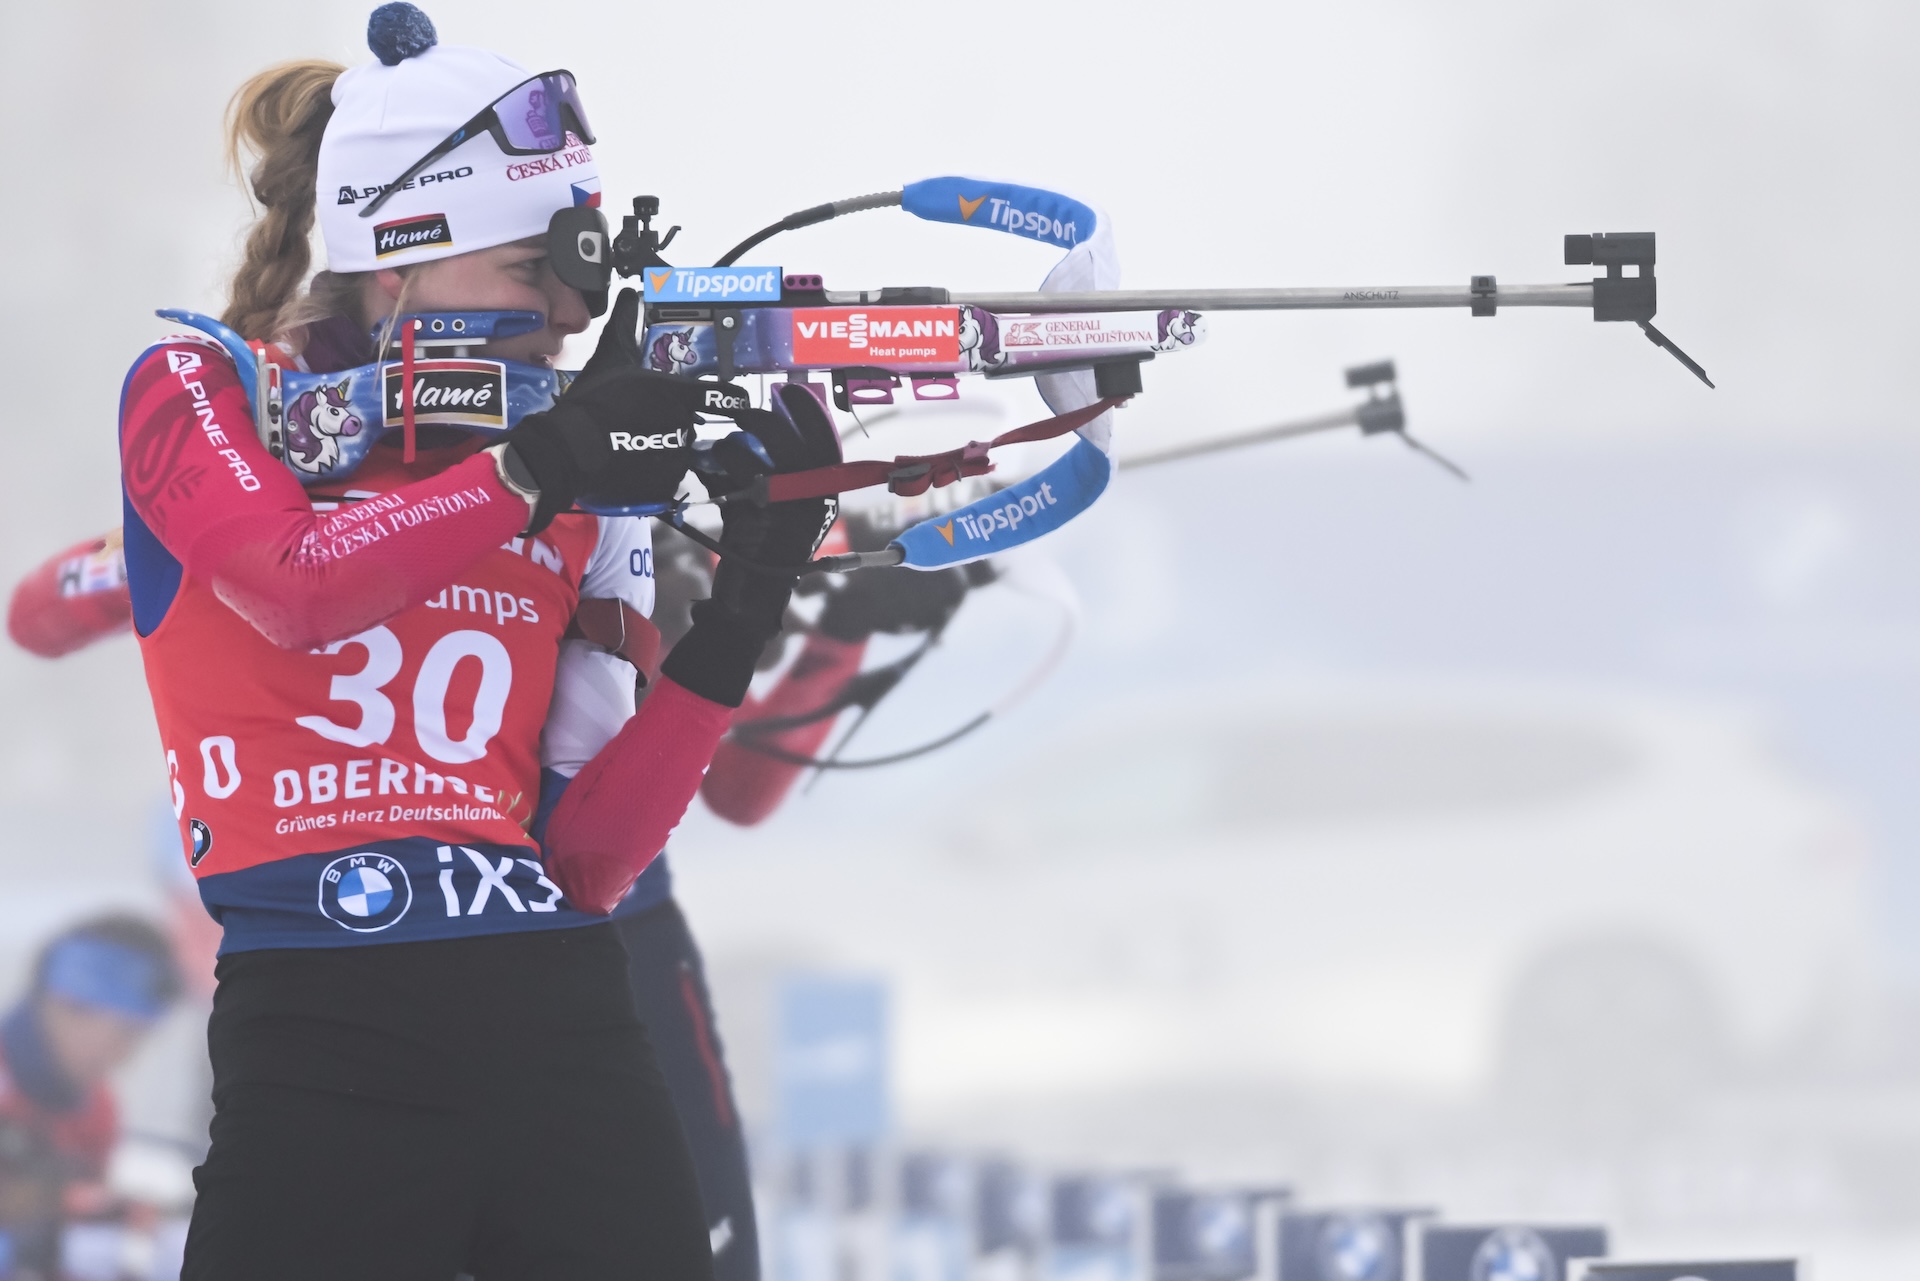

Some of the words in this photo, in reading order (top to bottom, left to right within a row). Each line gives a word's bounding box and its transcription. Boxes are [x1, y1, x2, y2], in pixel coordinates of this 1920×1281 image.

[420, 166, 473, 187] PRO
[506, 153, 563, 181] ČESKÁ
[380, 224, 442, 249] Hamé
[990, 197, 1076, 246] Tipsport
[675, 270, 775, 298] Tipsport
[797, 313, 954, 349] VIESSMANN
[1045, 320, 1101, 333] GENERALI
[1046, 333, 1081, 346] ČESKÁ
[1085, 330, 1153, 345] POJIŠŤOVNA
[870, 347, 896, 357] Heat
[899, 348, 937, 357] pumps
[166, 350, 230, 447] ALPINE
[218, 448, 261, 492] PRO
[323, 493, 406, 537] GENERALI
[331, 518, 390, 559] ČESKÁ
[388, 486, 492, 532] POJIŠŤOVNA
[956, 481, 1058, 542] Tipsport
[295, 625, 513, 764] 30
[275, 812, 337, 835] Grünes
[342, 808, 384, 825] Herz
[389, 803, 506, 823] Deutschlan
[326, 856, 395, 884] BMW
